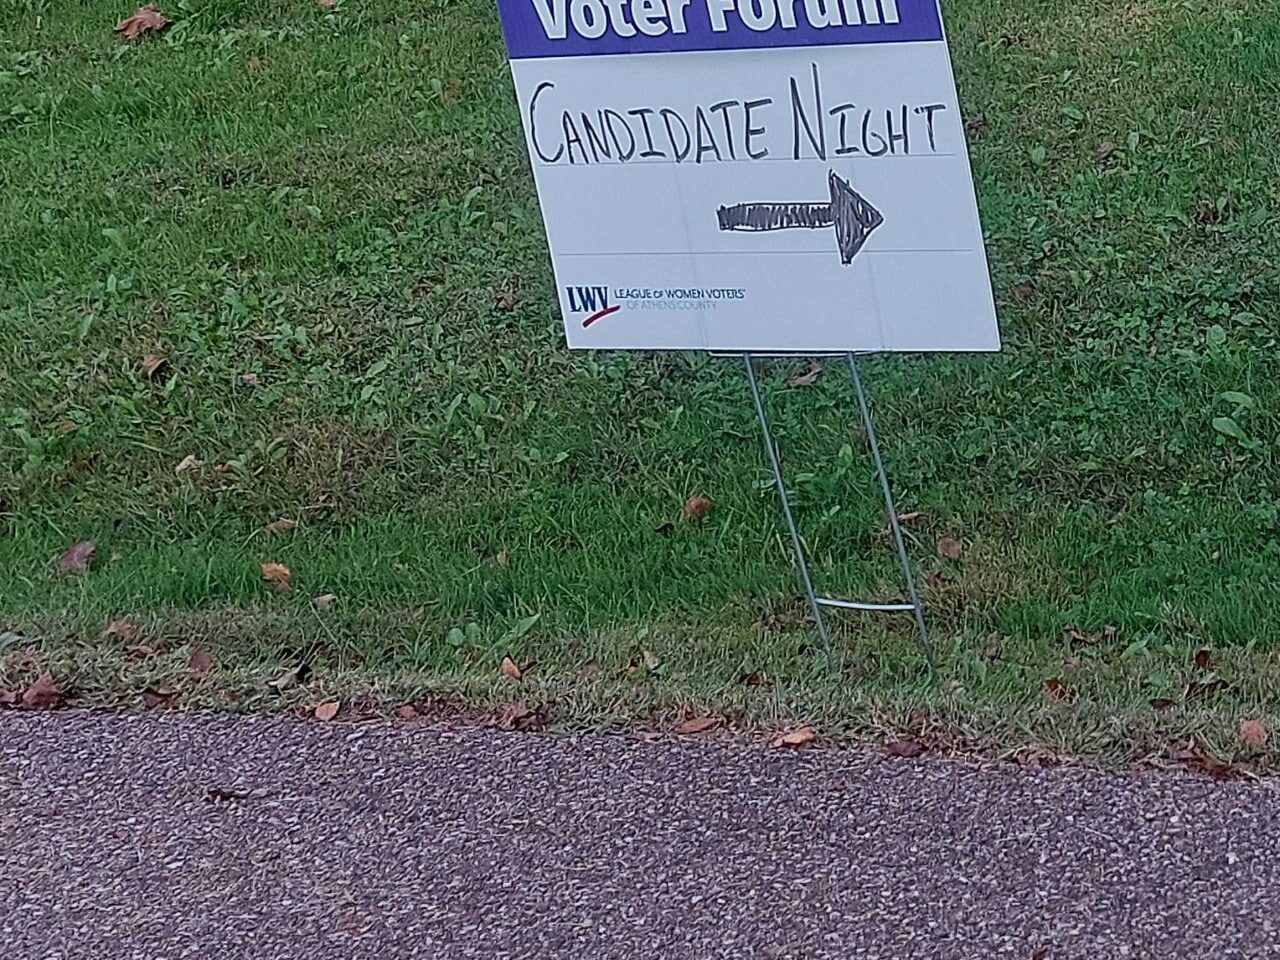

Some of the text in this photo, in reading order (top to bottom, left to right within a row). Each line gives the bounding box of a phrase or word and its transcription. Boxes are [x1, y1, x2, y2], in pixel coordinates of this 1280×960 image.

[529, 62, 946, 165] CANDIDATE NIGHT
[566, 286, 608, 312] LWV
[614, 289, 652, 299] LEAGUE
[667, 289, 705, 299] WOMEN
[626, 300, 718, 310] OF ATHENS COUNTY
